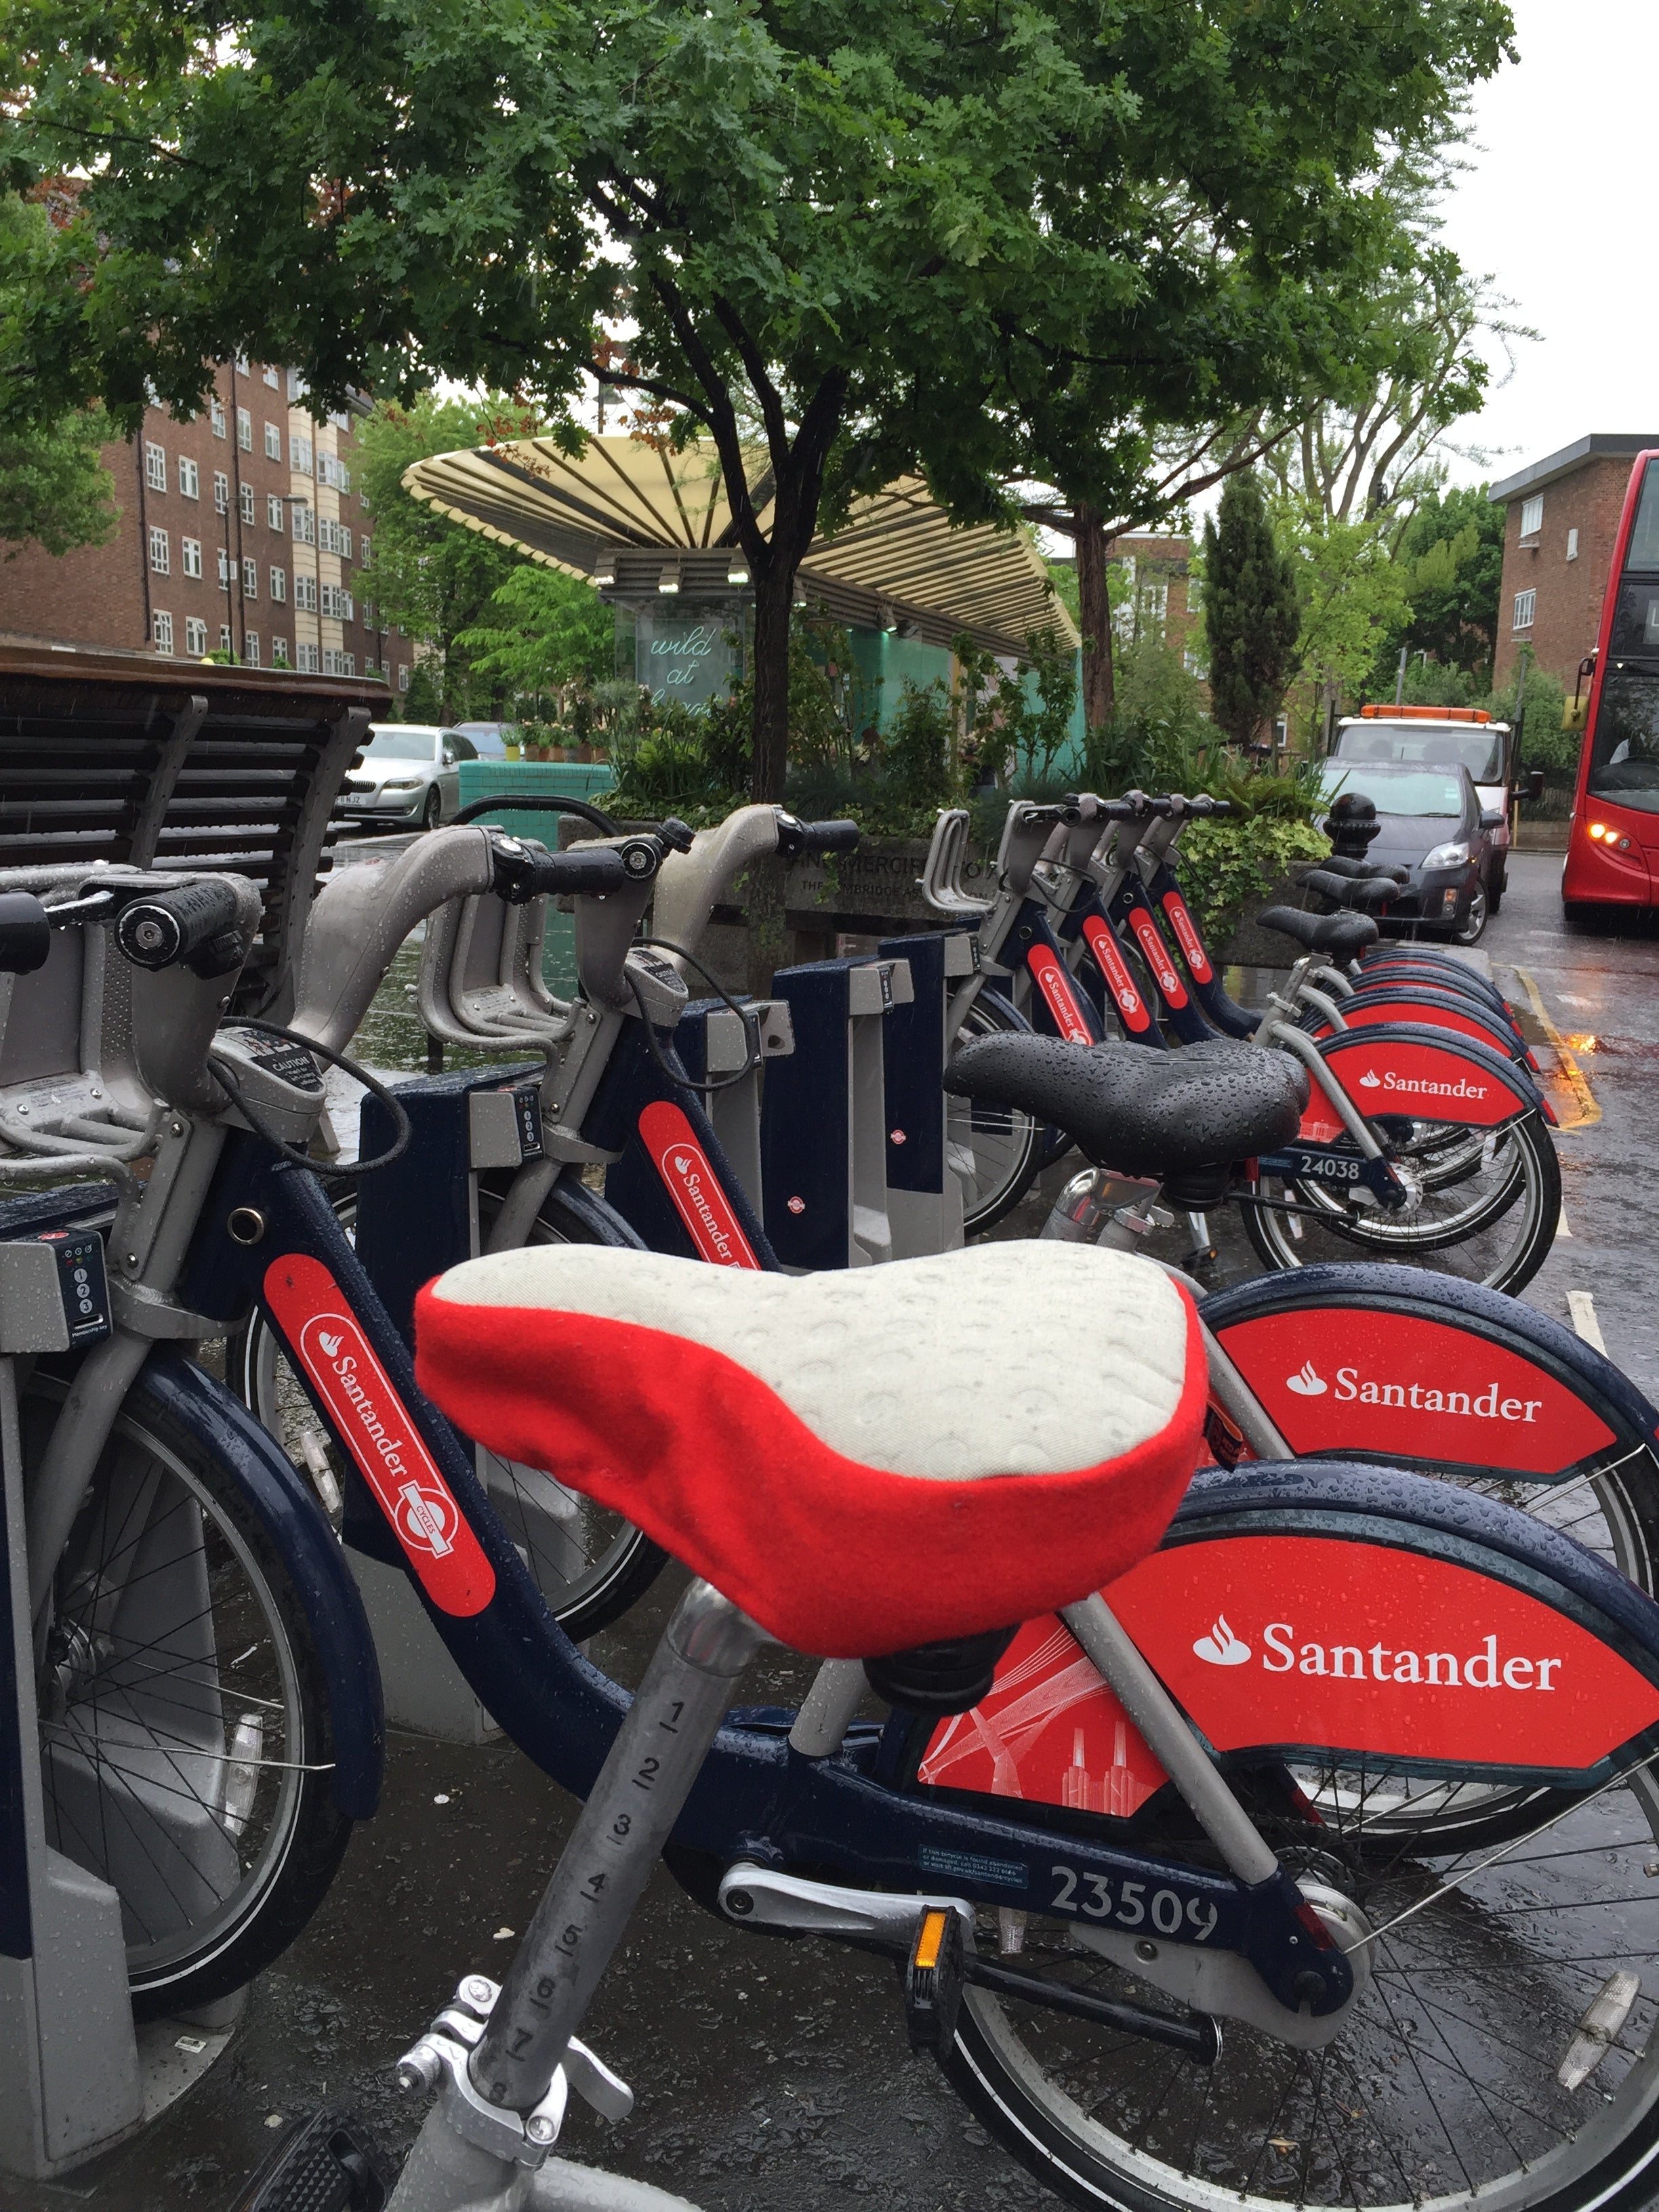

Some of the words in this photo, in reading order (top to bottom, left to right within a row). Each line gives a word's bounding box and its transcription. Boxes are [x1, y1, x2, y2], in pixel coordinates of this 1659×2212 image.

[651, 626, 717, 656] wild
[666, 659, 700, 684] at
[1177, 916, 1193, 949] Santander
[1145, 936, 1166, 970] Santander
[1102, 947, 1124, 987] Santander
[1049, 981, 1075, 1028] Santander
[272, 1056, 310, 1072] CAUTION
[1383, 1071, 1488, 1099] Santander
[1300, 1155, 1359, 1180] 24038
[683, 1173, 733, 1259] Santander
[79, 1271, 83, 1280] 1
[80, 1286, 87, 1296] 2
[83, 1301, 89, 1311] 3
[72, 1327, 99, 1338] Membership
[1334, 1367, 1542, 1422] Santander
[332, 1355, 408, 1477] Santander
[416, 1505, 436, 1534] CYCLES
[1263, 1623, 1561, 1691] Santander
[672, 1701, 684, 1723] 1
[638, 1757, 659, 1782] 2
[613, 1814, 632, 1836] 3
[941, 1851, 962, 1860] bicycle
[970, 1856, 988, 1864] found
[989, 1860, 1023, 1871] abandoned
[588, 1872, 606, 1893] 4
[1051, 1866, 1218, 1941] 23509
[562, 1923, 583, 1946] 5
[536, 1976, 556, 1999] 6
[514, 2027, 533, 2053] 7
